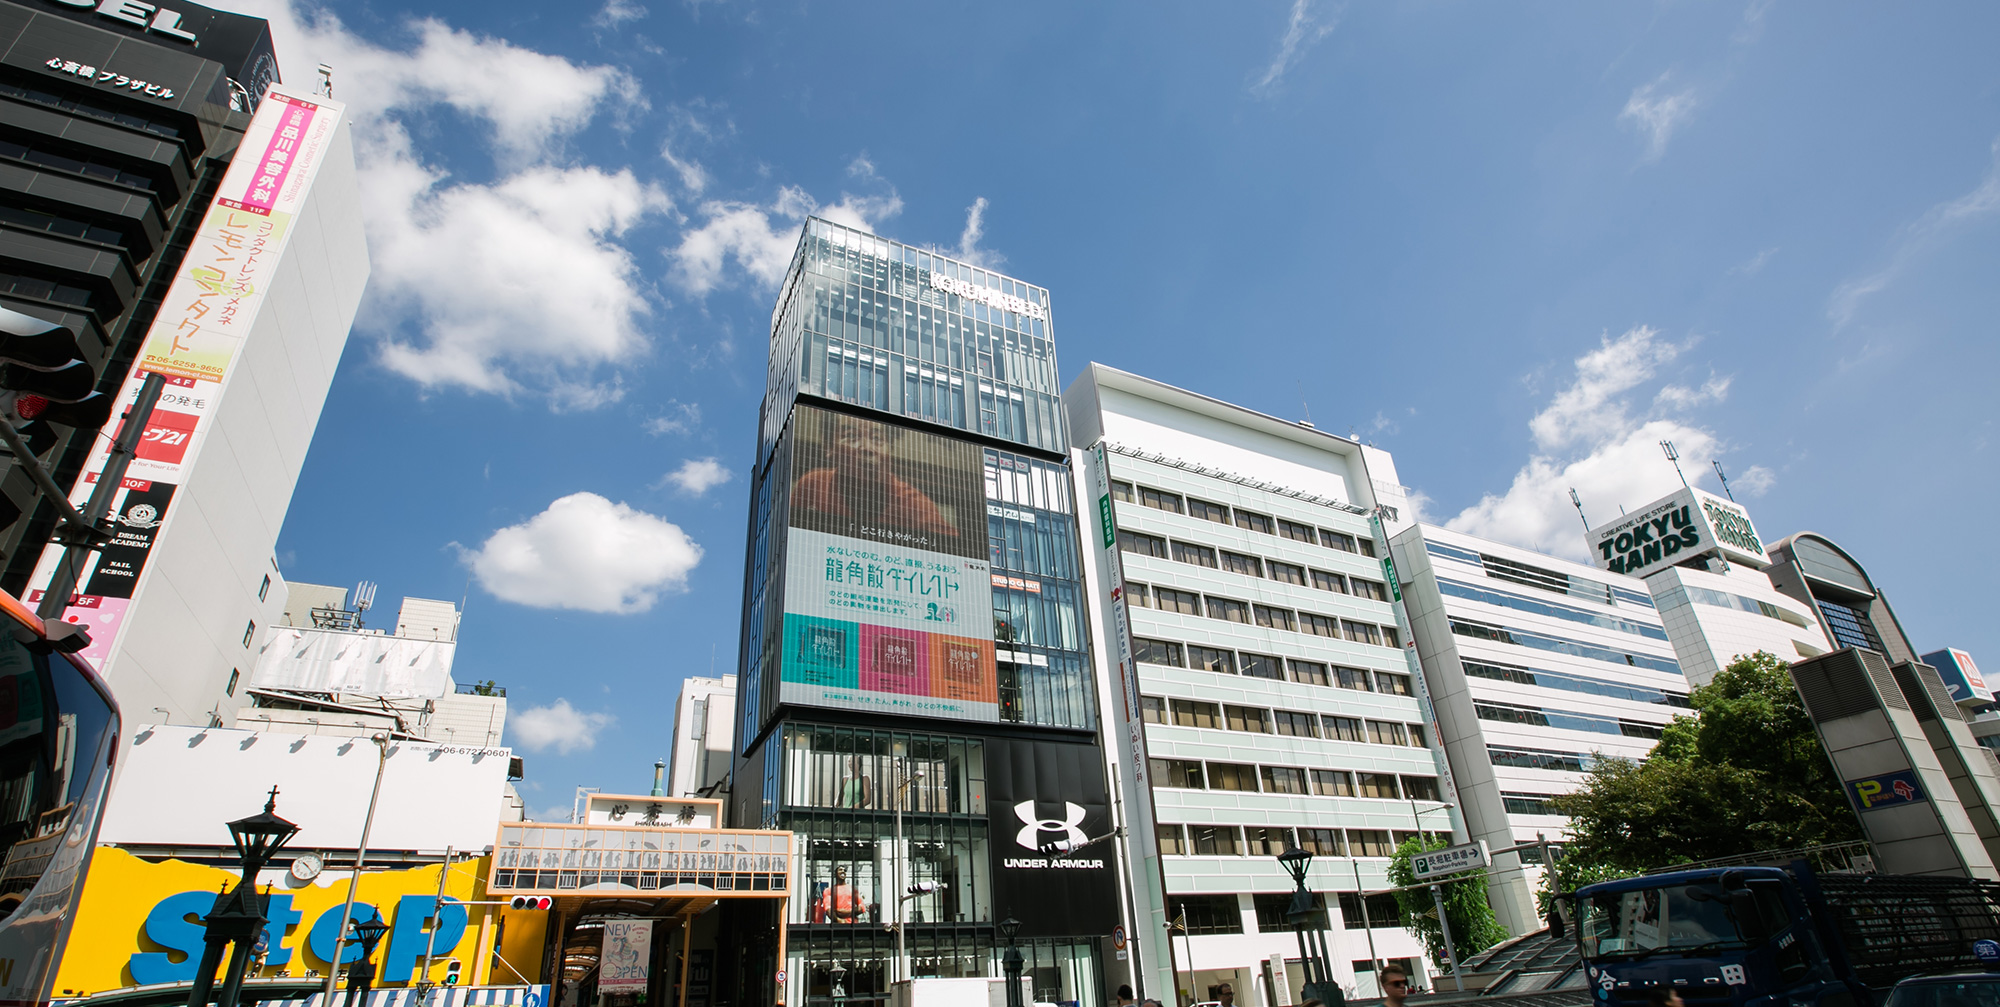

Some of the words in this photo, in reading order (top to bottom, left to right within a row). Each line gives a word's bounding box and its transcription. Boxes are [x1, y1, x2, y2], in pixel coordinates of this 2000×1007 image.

[99, 71, 174, 99] プラザビル
[251, 126, 300, 204] 品川美容外科
[250, 206, 265, 214] 11F
[170, 212, 249, 356] レモンコンタクト
[156, 356, 223, 374] 06-6258-9650
[124, 479, 146, 488] 10F
[1601, 520, 1635, 539] CREATIVE
[1635, 513, 1650, 525] LIFE
[1651, 501, 1676, 516] STORE
[1703, 502, 1754, 537] TOKYU
[117, 532, 148, 541] DREAM
[1598, 505, 1692, 560] TOKYU
[109, 538, 151, 549] ACADEMY
[1607, 525, 1700, 574] HANDS
[100, 568, 135, 577] SCHOOL
[110, 561, 131, 569] NAIL
[825, 557, 960, 599] 龍角散ダイレクト
[992, 577, 1015, 587] STUDIO
[77, 597, 94, 606] 5F
[1130, 724, 1143, 783] いぬい皮フ科
[1003, 858, 1048, 869] UNDER
[1050, 858, 1104, 869] ARMOUR
